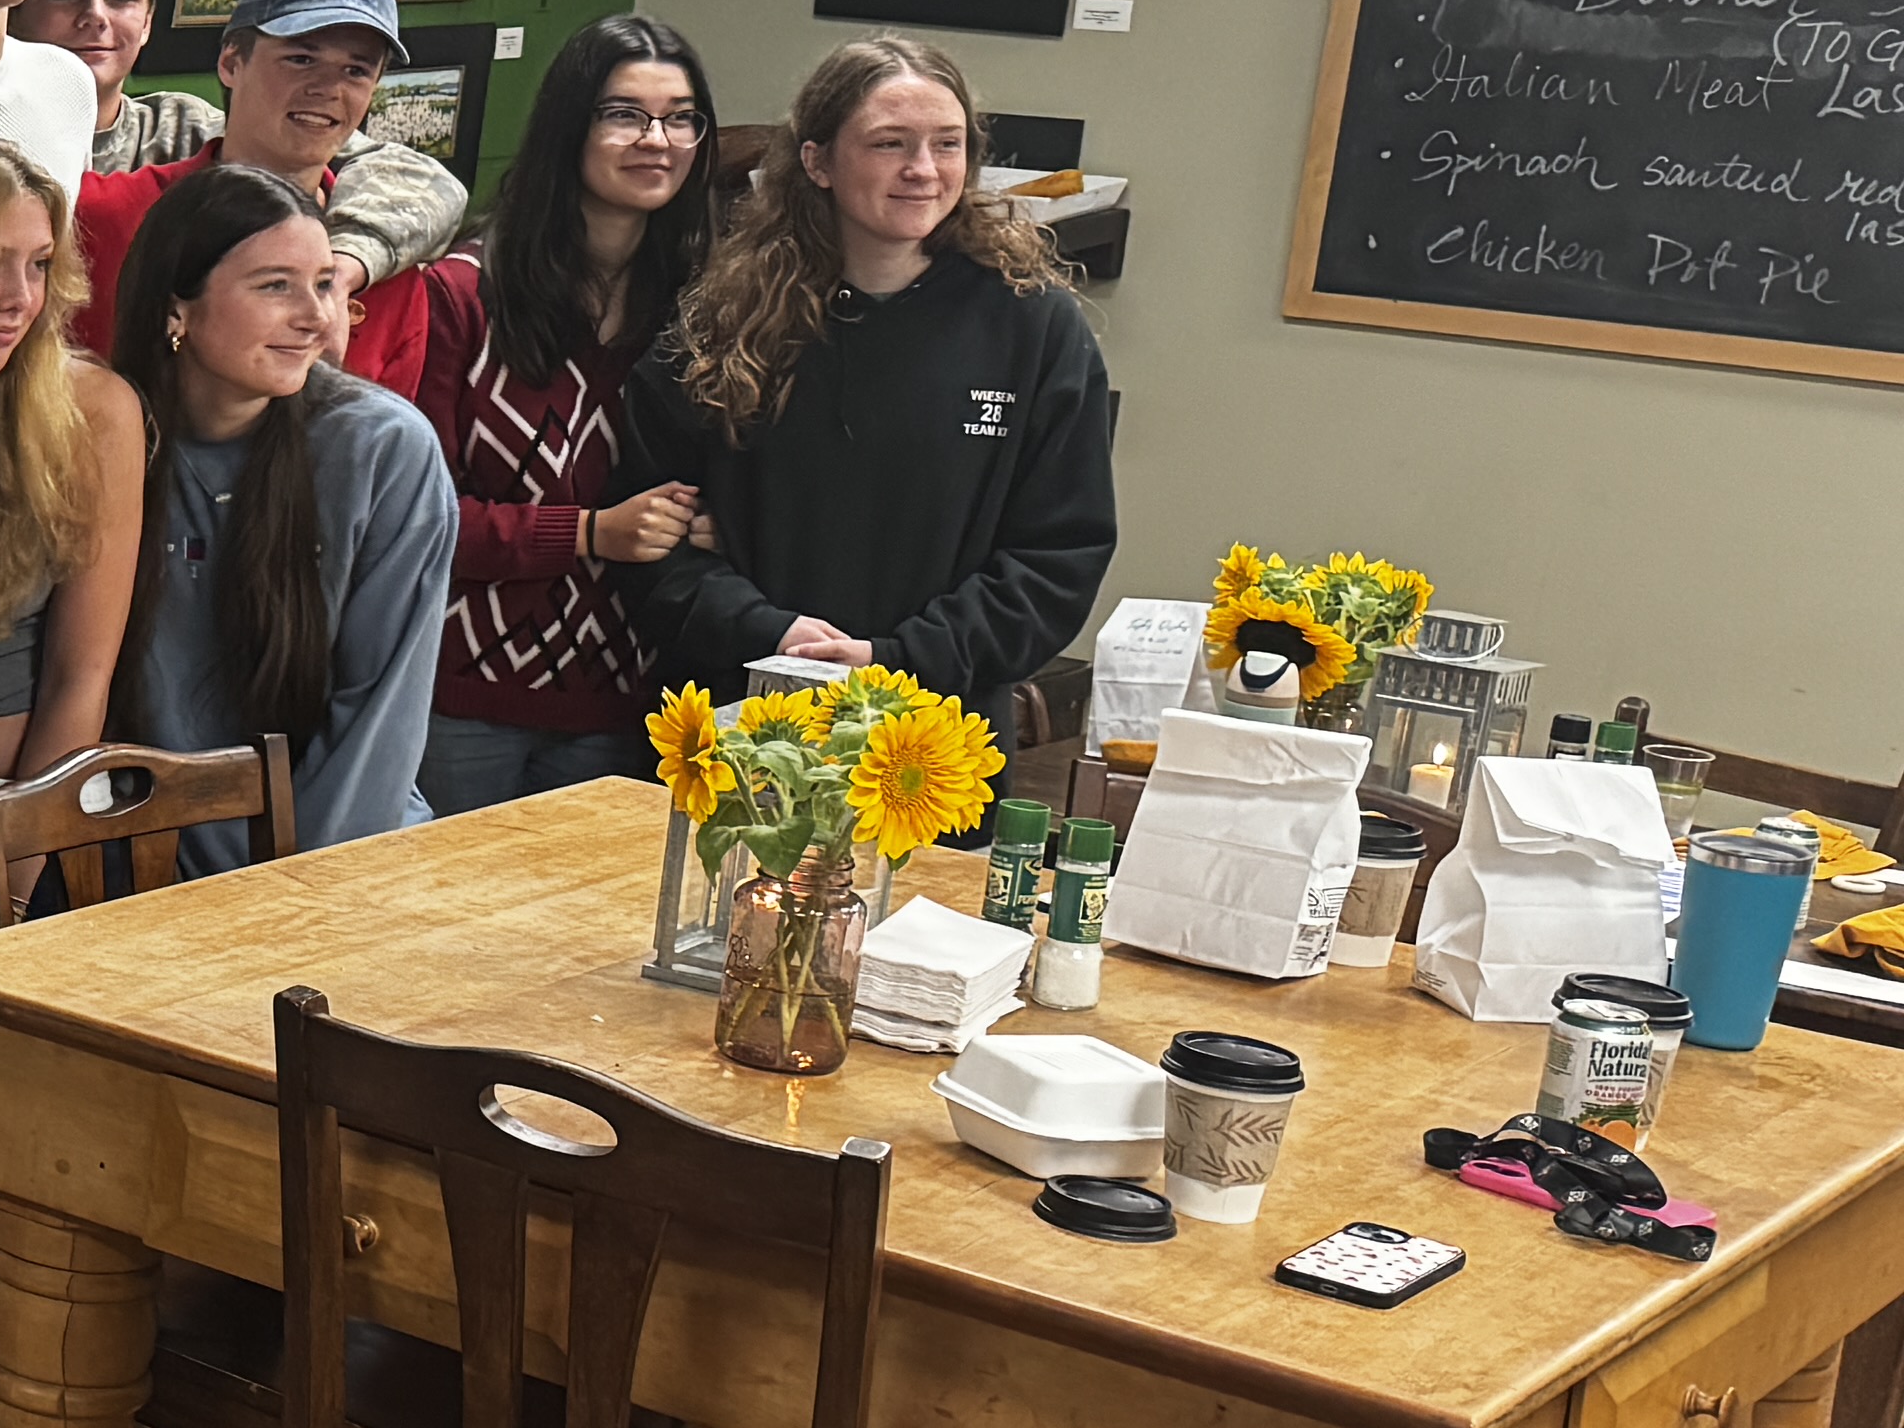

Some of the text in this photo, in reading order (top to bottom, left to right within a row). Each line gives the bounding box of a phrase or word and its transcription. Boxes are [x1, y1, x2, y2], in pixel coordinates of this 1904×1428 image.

[1404, 44, 1621, 105] Italian
[1655, 59, 1794, 114] Meat
[1426, 219, 1840, 305] Chicken Pot Pie
[970, 389, 1016, 404] WIESEN
[980, 403, 1003, 423] 28
[963, 423, 995, 436] TEAM
